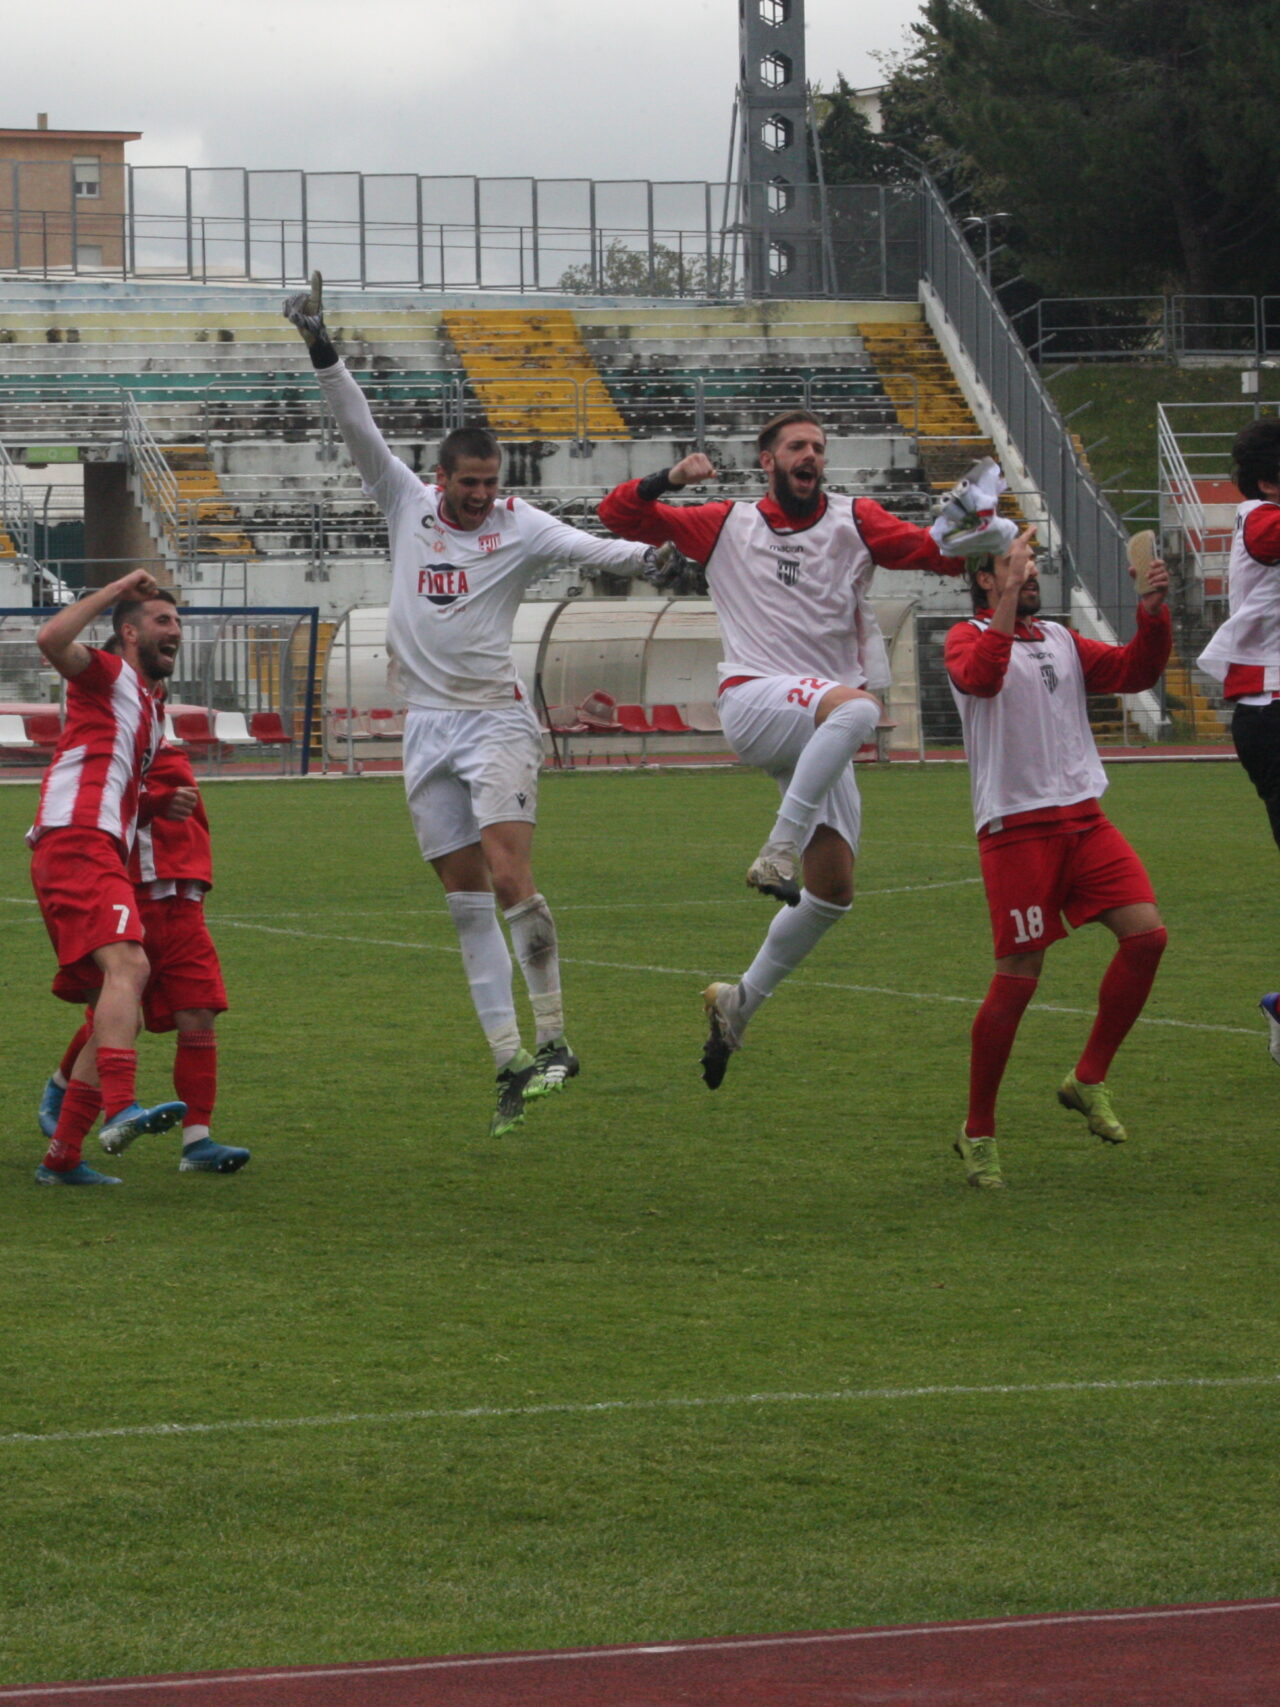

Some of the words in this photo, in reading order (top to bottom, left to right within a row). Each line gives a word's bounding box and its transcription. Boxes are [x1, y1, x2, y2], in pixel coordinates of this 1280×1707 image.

[786, 677, 829, 708] 22
[112, 904, 130, 934] 7
[1010, 905, 1044, 943] 18
